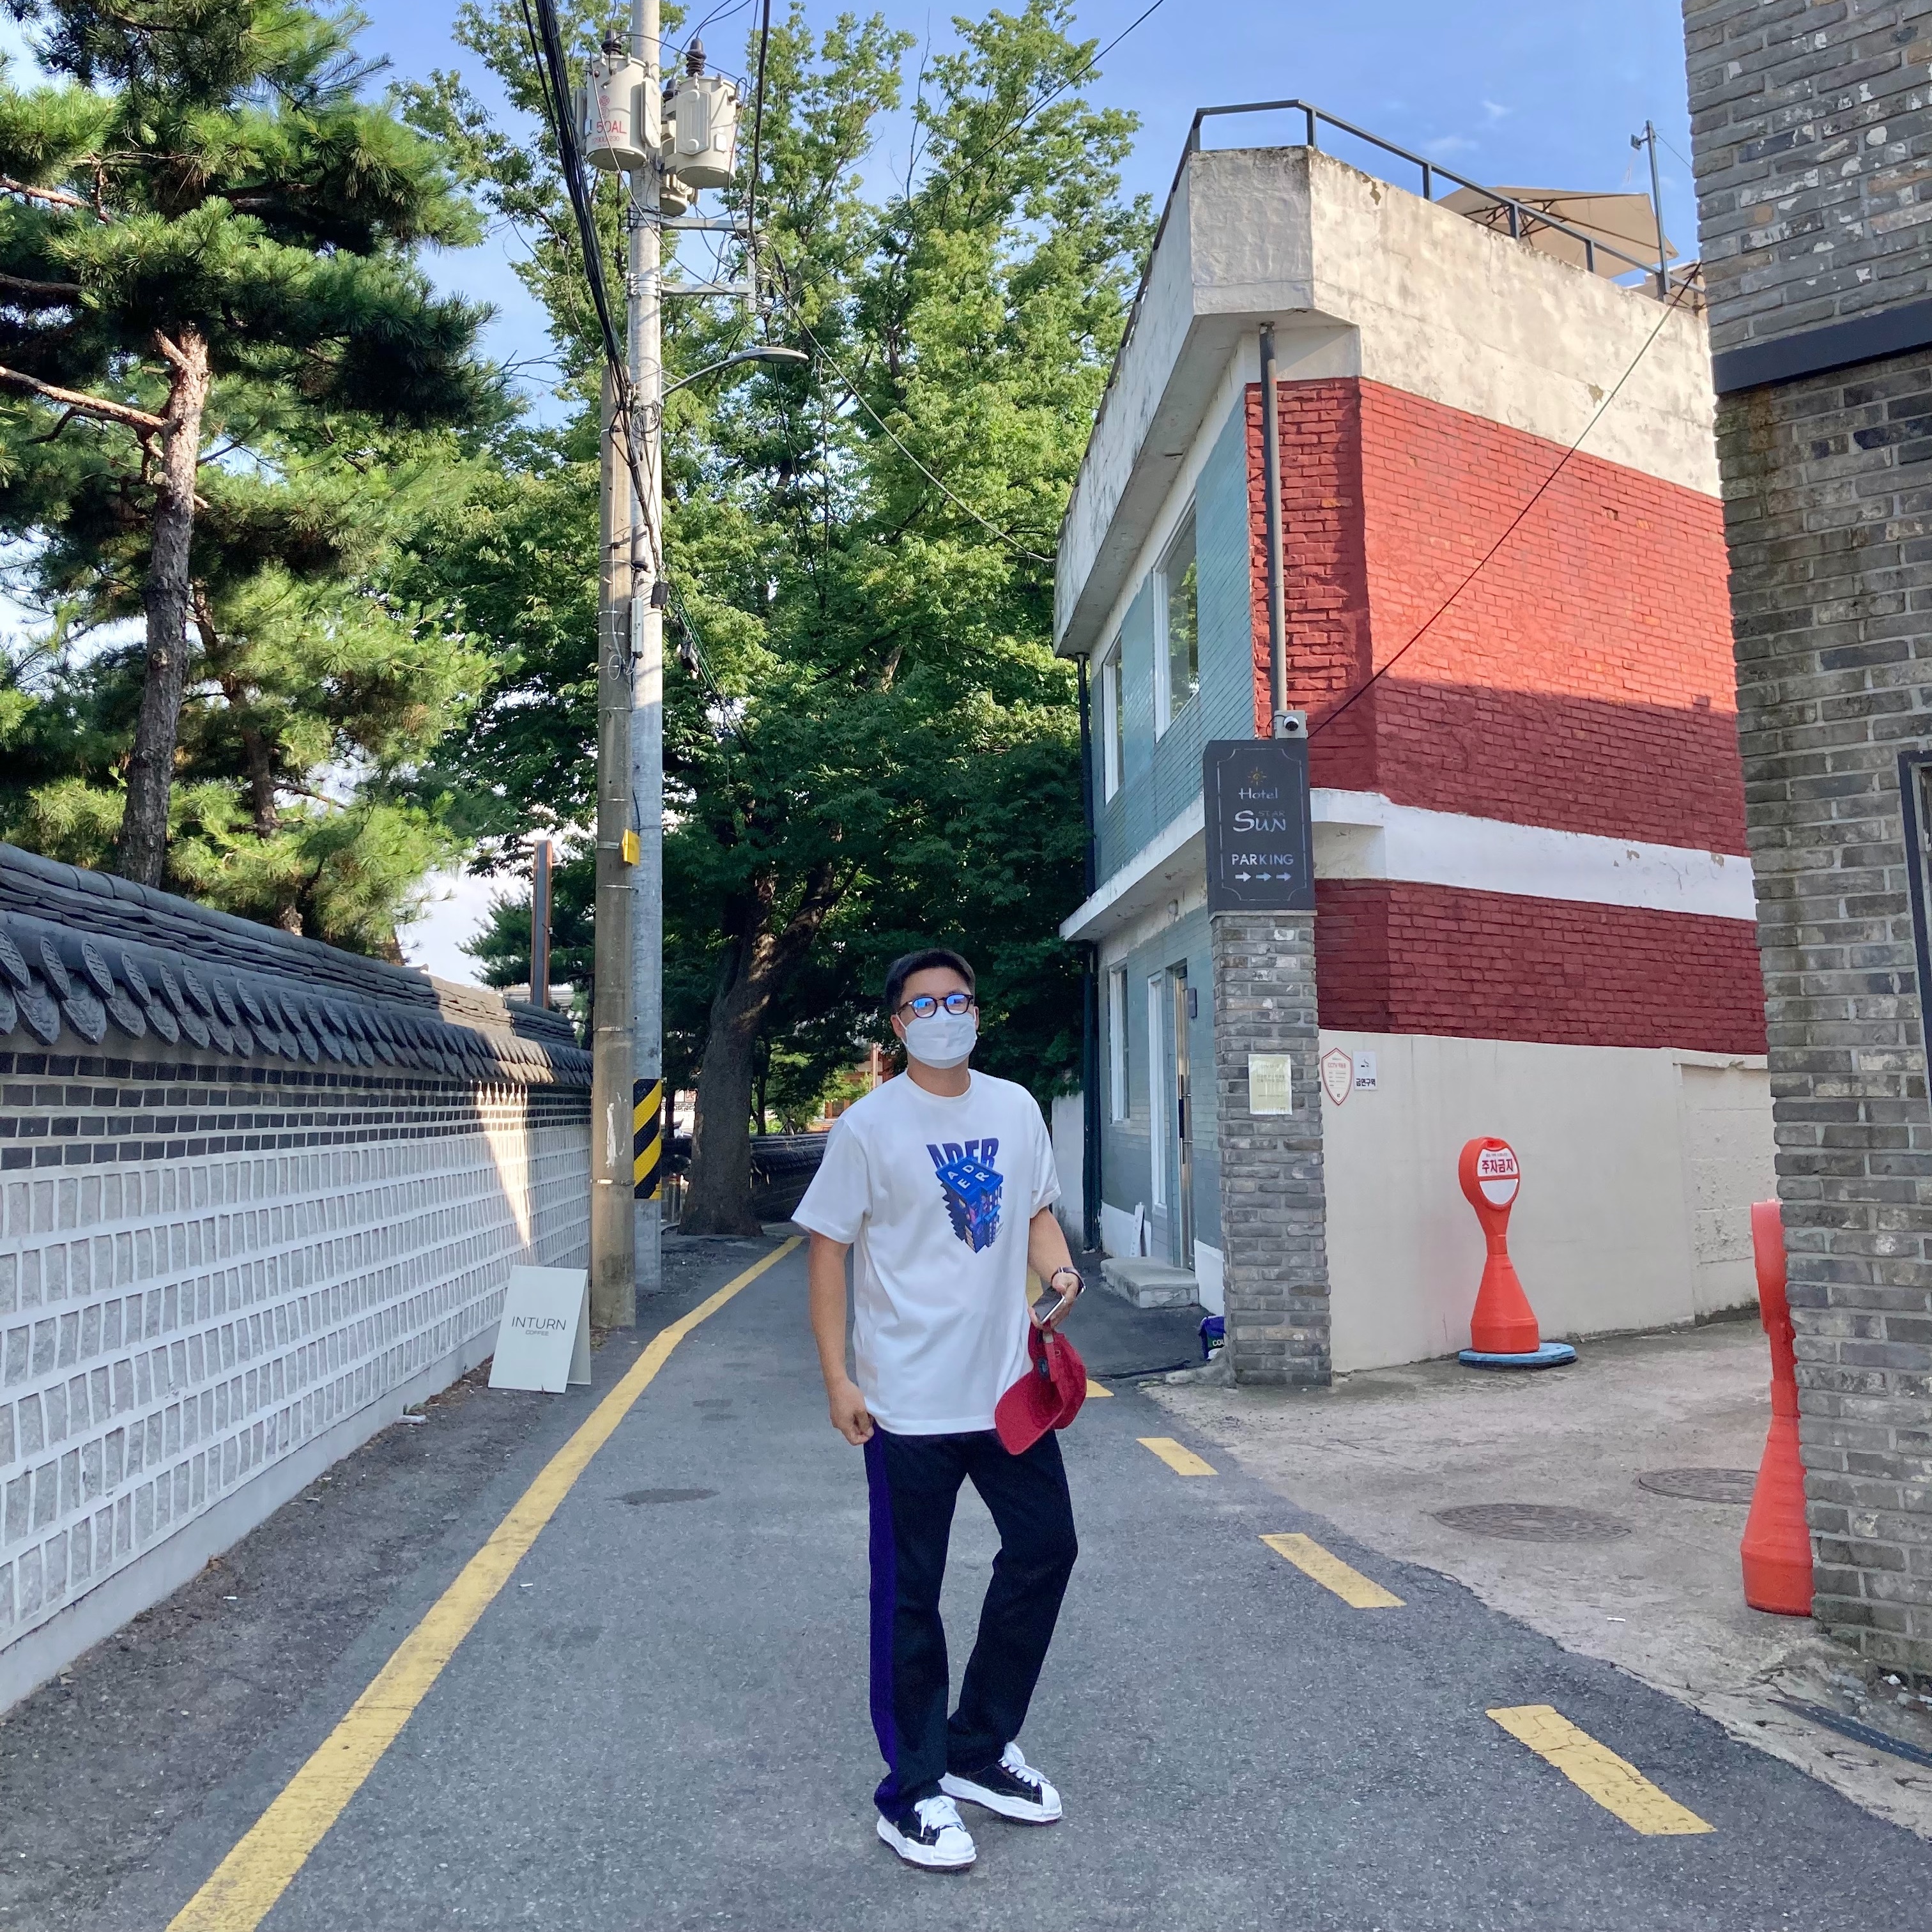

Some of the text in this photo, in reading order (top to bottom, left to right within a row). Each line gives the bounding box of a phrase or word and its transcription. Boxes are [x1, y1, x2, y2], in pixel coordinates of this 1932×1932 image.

[1238, 787, 1278, 800] Hotel
[1232, 854, 1294, 866] PARKING
[1356, 1078, 1376, 1087] 금연구역
[1482, 1158, 1514, 1174] 주차금지
[511, 1316, 567, 1331] INTURN
